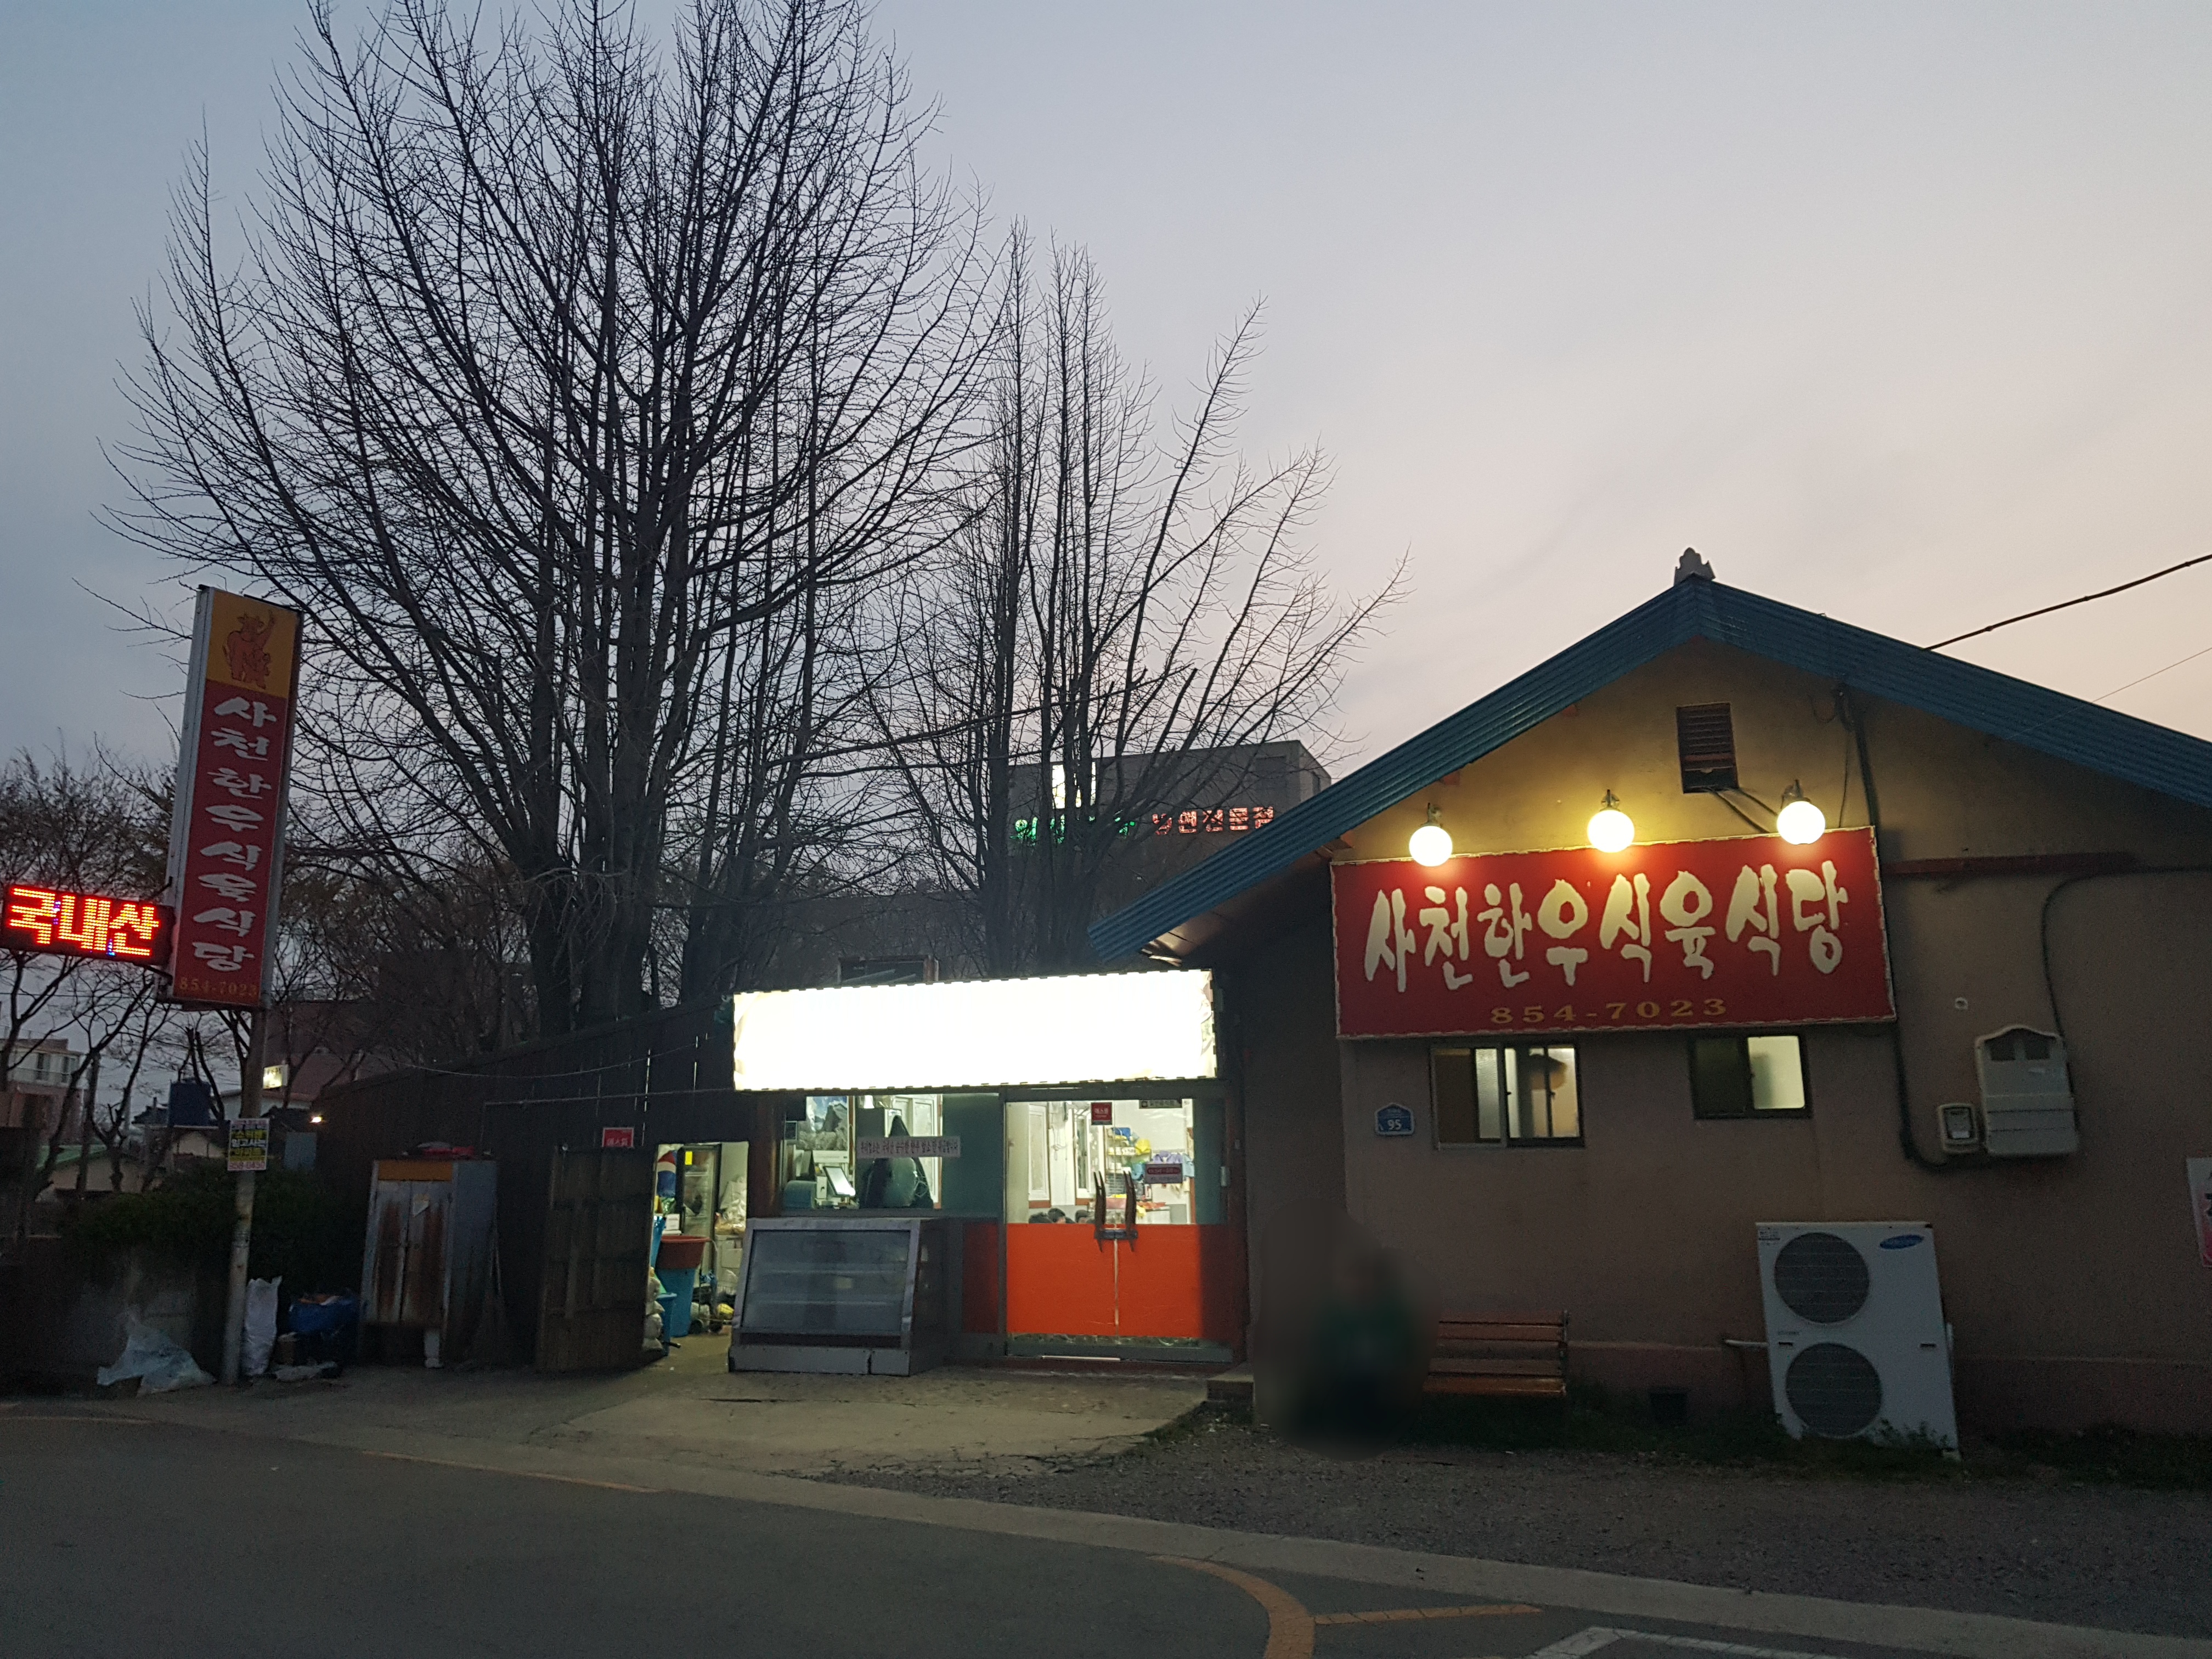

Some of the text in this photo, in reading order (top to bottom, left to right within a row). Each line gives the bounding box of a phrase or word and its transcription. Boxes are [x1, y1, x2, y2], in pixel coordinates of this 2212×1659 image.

[193, 696, 276, 972] 사천한우식육식당
[8, 887, 160, 956] 국내산
[1364, 860, 1849, 993] 사천한우식육식당
[1490, 998, 1727, 1025] 854-7023
[1387, 1119, 1402, 1131] 95
